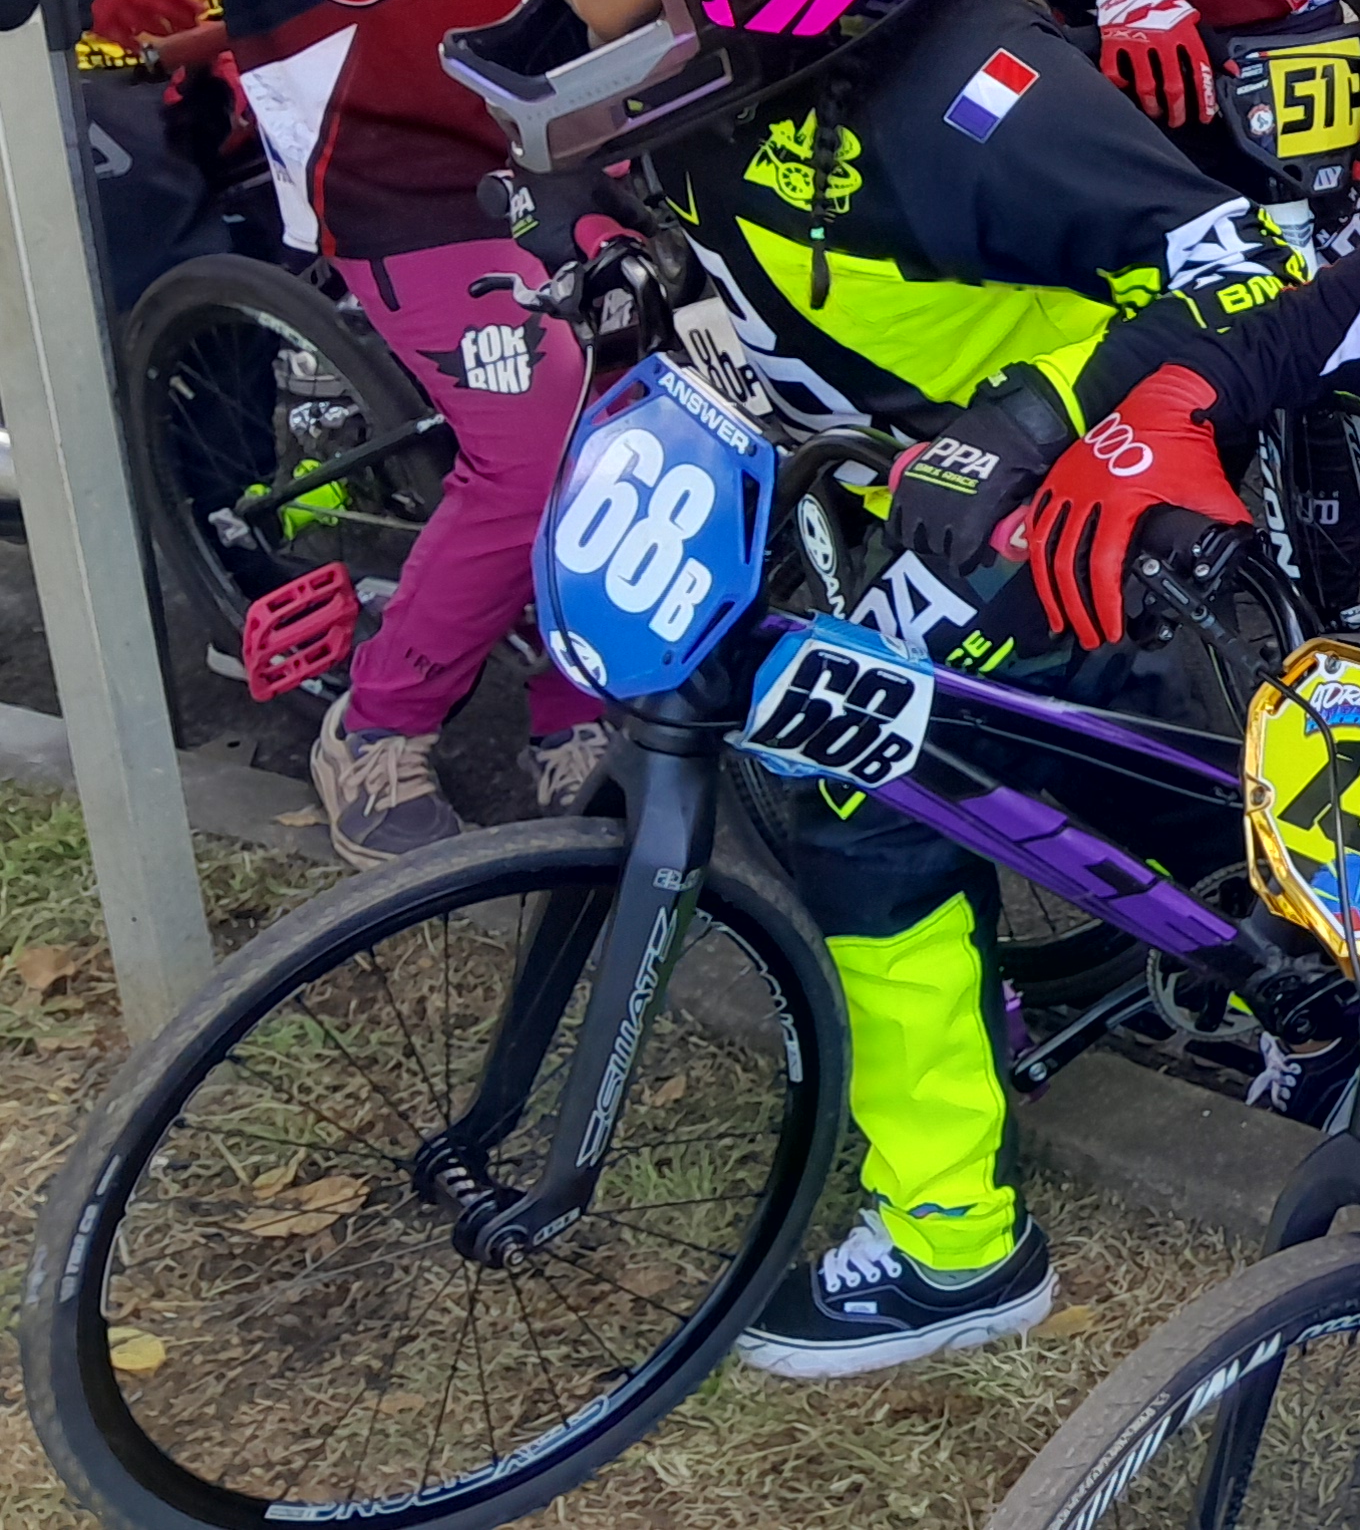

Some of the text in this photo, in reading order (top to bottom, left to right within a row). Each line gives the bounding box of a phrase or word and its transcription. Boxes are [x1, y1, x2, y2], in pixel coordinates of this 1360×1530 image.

[658, 371, 752, 456] ANSWER
[921, 435, 1000, 480] PPA
[555, 427, 716, 643] 68B
